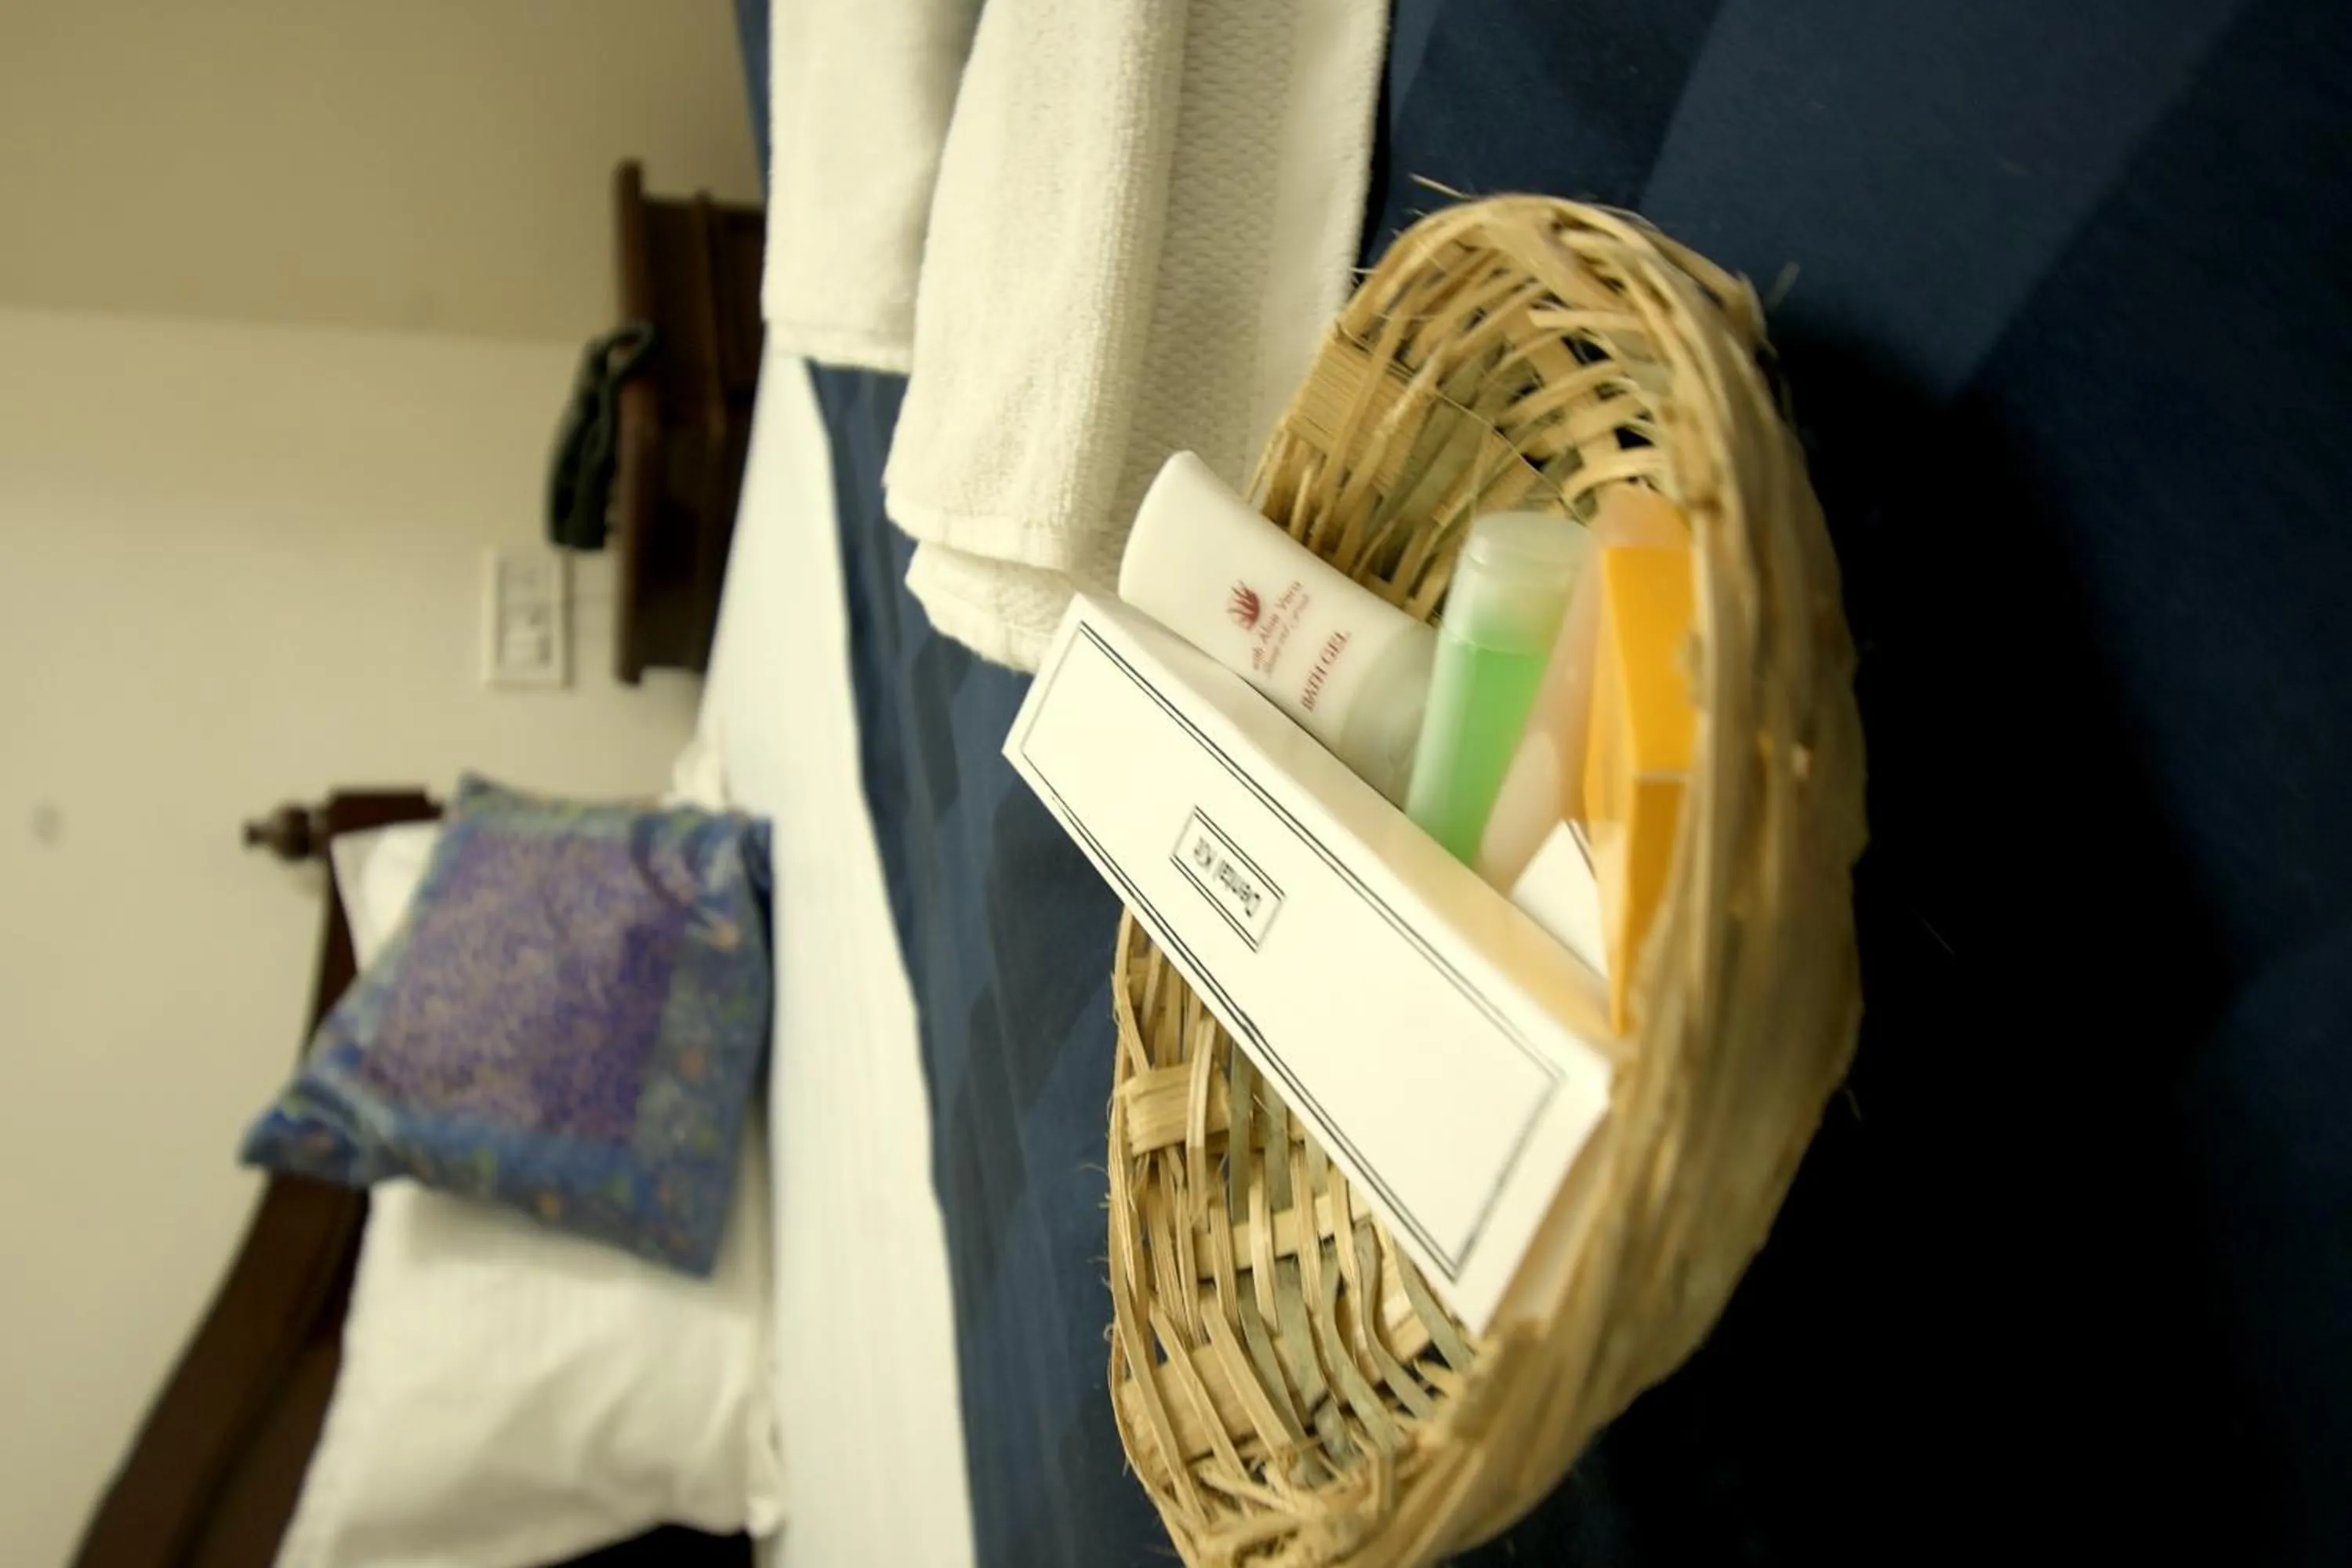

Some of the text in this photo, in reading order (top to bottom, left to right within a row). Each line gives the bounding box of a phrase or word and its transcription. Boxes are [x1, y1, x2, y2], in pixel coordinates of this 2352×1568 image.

[1301, 630, 1352, 713] BATH GEL
[1193, 834, 1262, 918] Dental Kit
